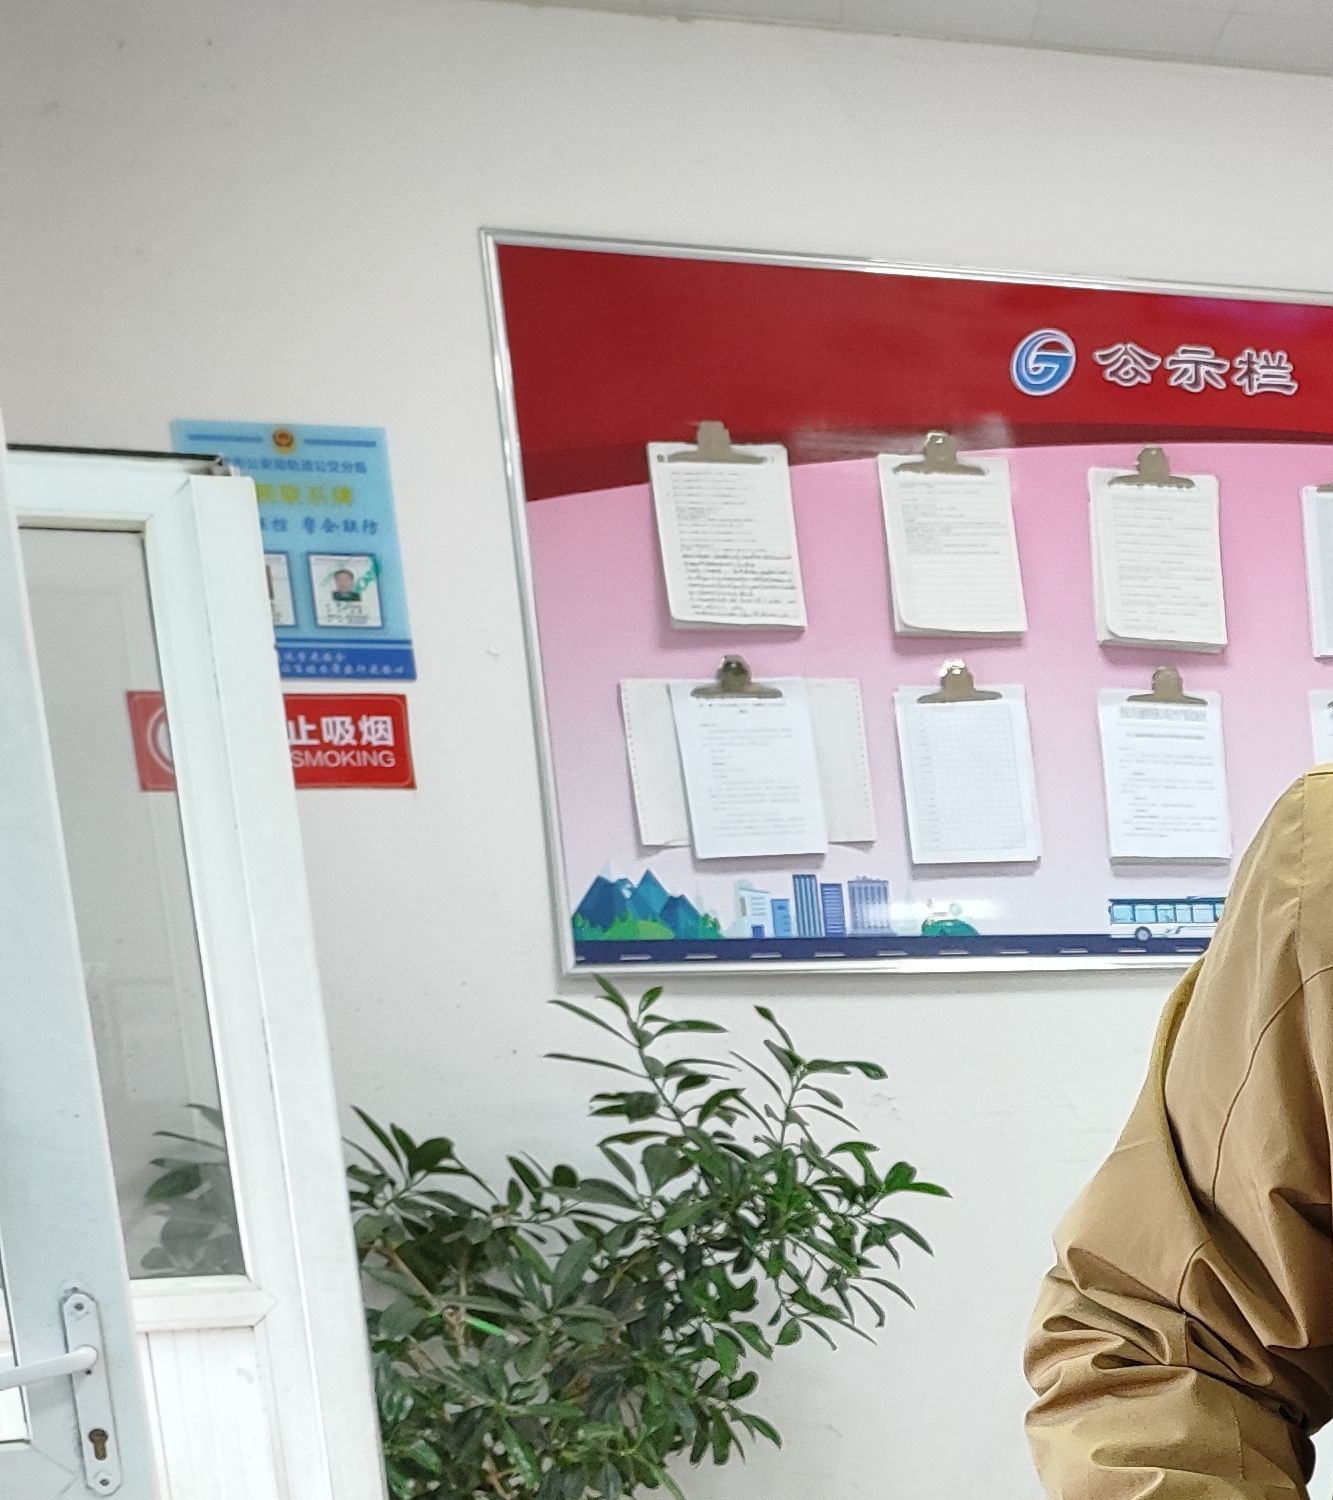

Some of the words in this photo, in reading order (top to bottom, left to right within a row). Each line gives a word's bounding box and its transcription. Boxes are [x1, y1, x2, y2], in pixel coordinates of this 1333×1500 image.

[1091, 342, 1298, 396] 公示栏
[287, 715, 395, 747] 止吸烟
[291, 750, 396, 768] SMOKING
